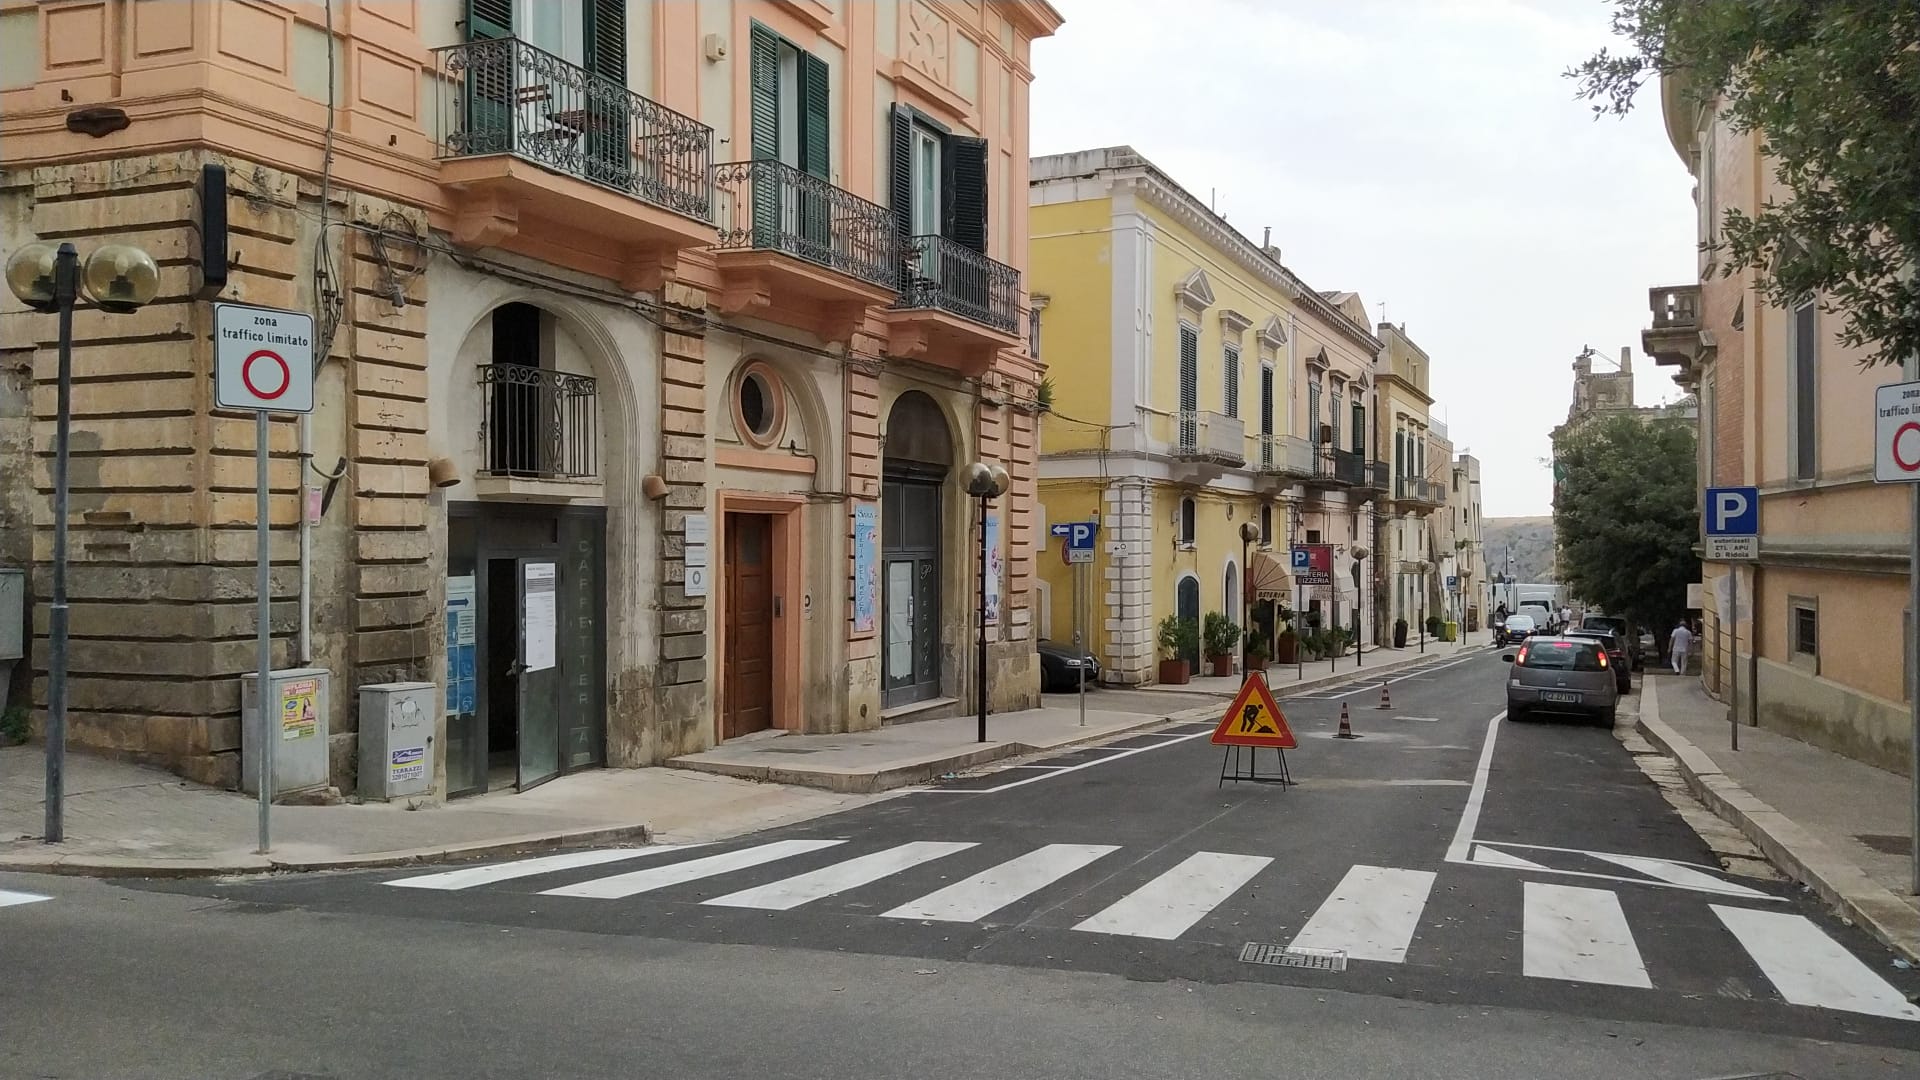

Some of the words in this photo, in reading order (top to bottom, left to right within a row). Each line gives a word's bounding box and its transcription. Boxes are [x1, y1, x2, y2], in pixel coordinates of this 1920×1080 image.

[254, 316, 277, 326] zona
[223, 327, 264, 342] traffico
[267, 331, 308, 347] limitato
[1902, 390, 1920, 399] zona
[1880, 405, 1910, 418] traffico
[1716, 492, 1747, 531] P
[1073, 525, 1090, 547] P
[1294, 551, 1306, 566] P
[1449, 577, 1455, 585] P
[1258, 591, 1285, 599] OSTERIA
[578, 541, 590, 745] CAFFETTERIA
